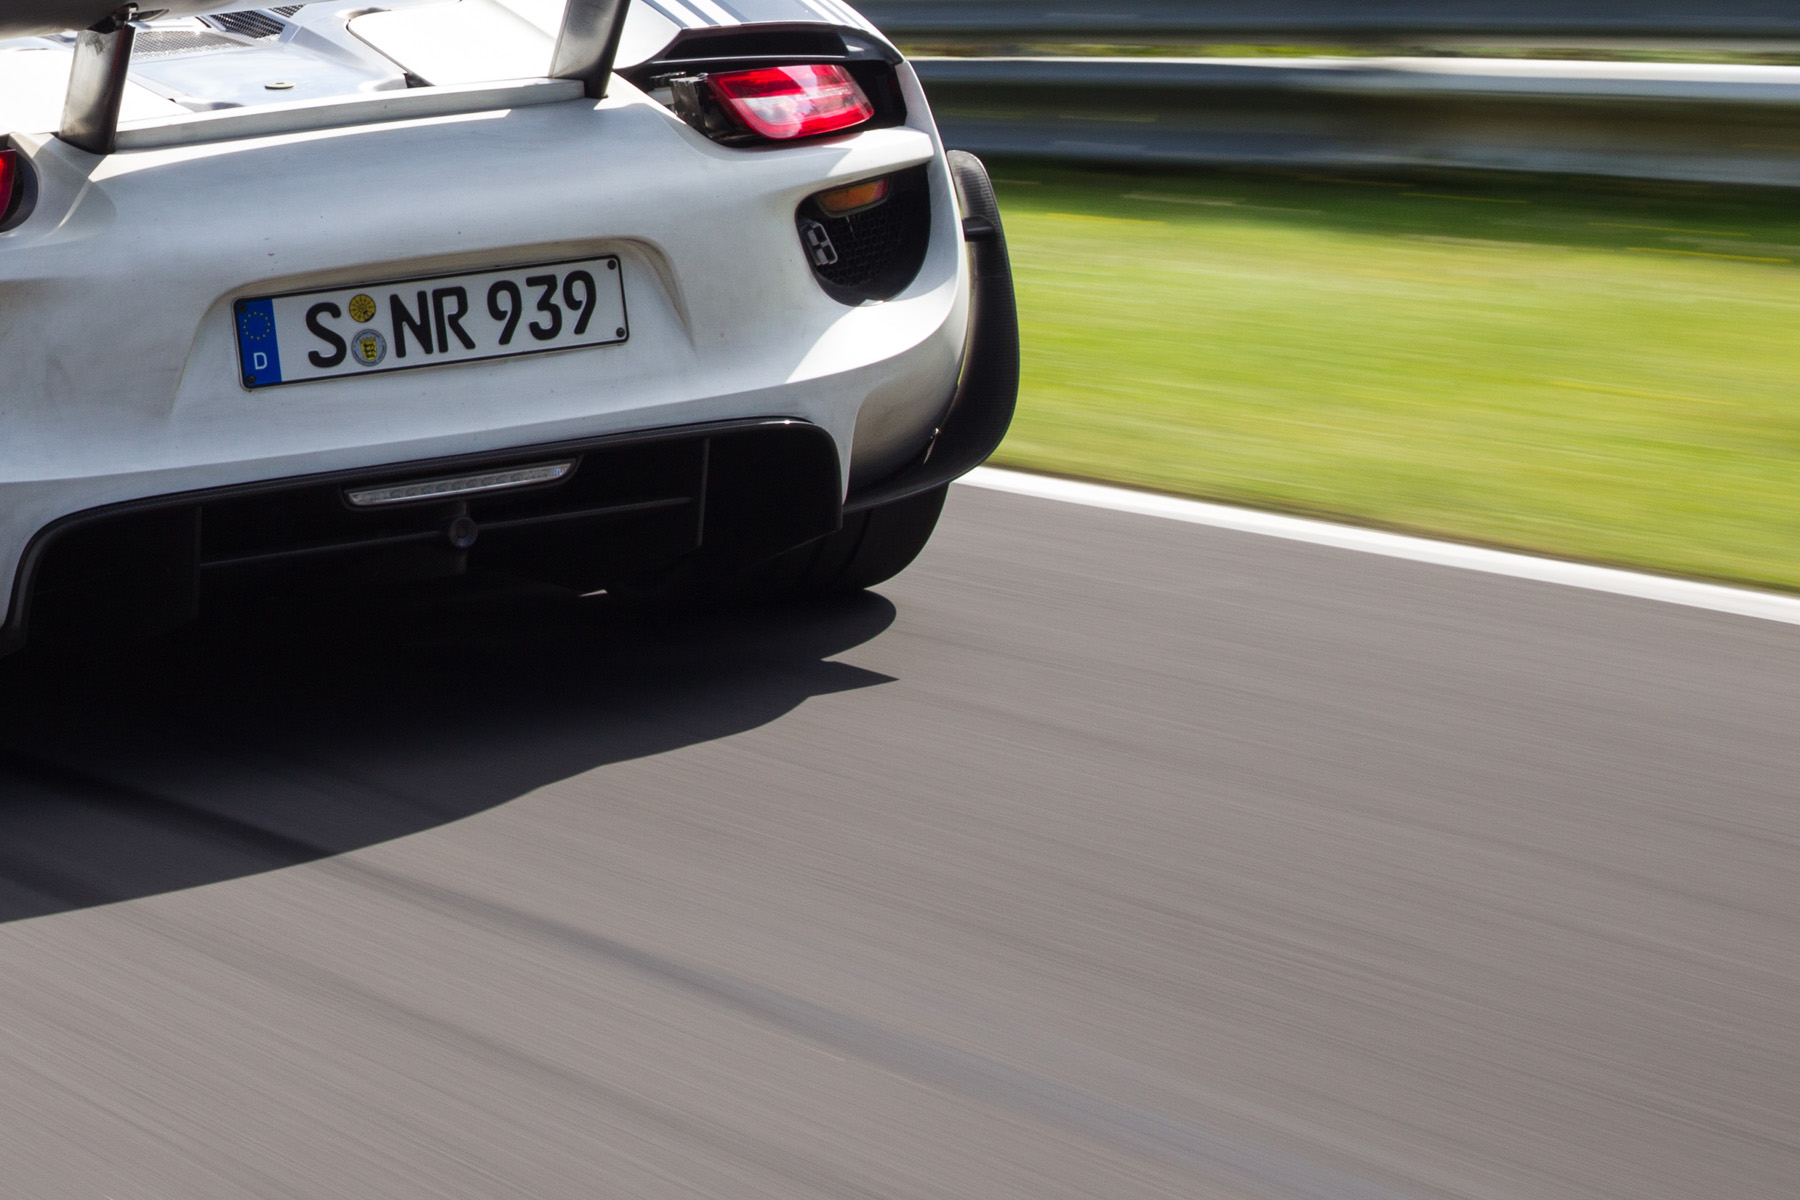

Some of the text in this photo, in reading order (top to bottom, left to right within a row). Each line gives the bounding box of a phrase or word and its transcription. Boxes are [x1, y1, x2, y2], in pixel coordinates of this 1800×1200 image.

[305, 302, 348, 368] S
[390, 286, 476, 359] NR
[486, 270, 597, 346] 939
[254, 352, 268, 371] D
